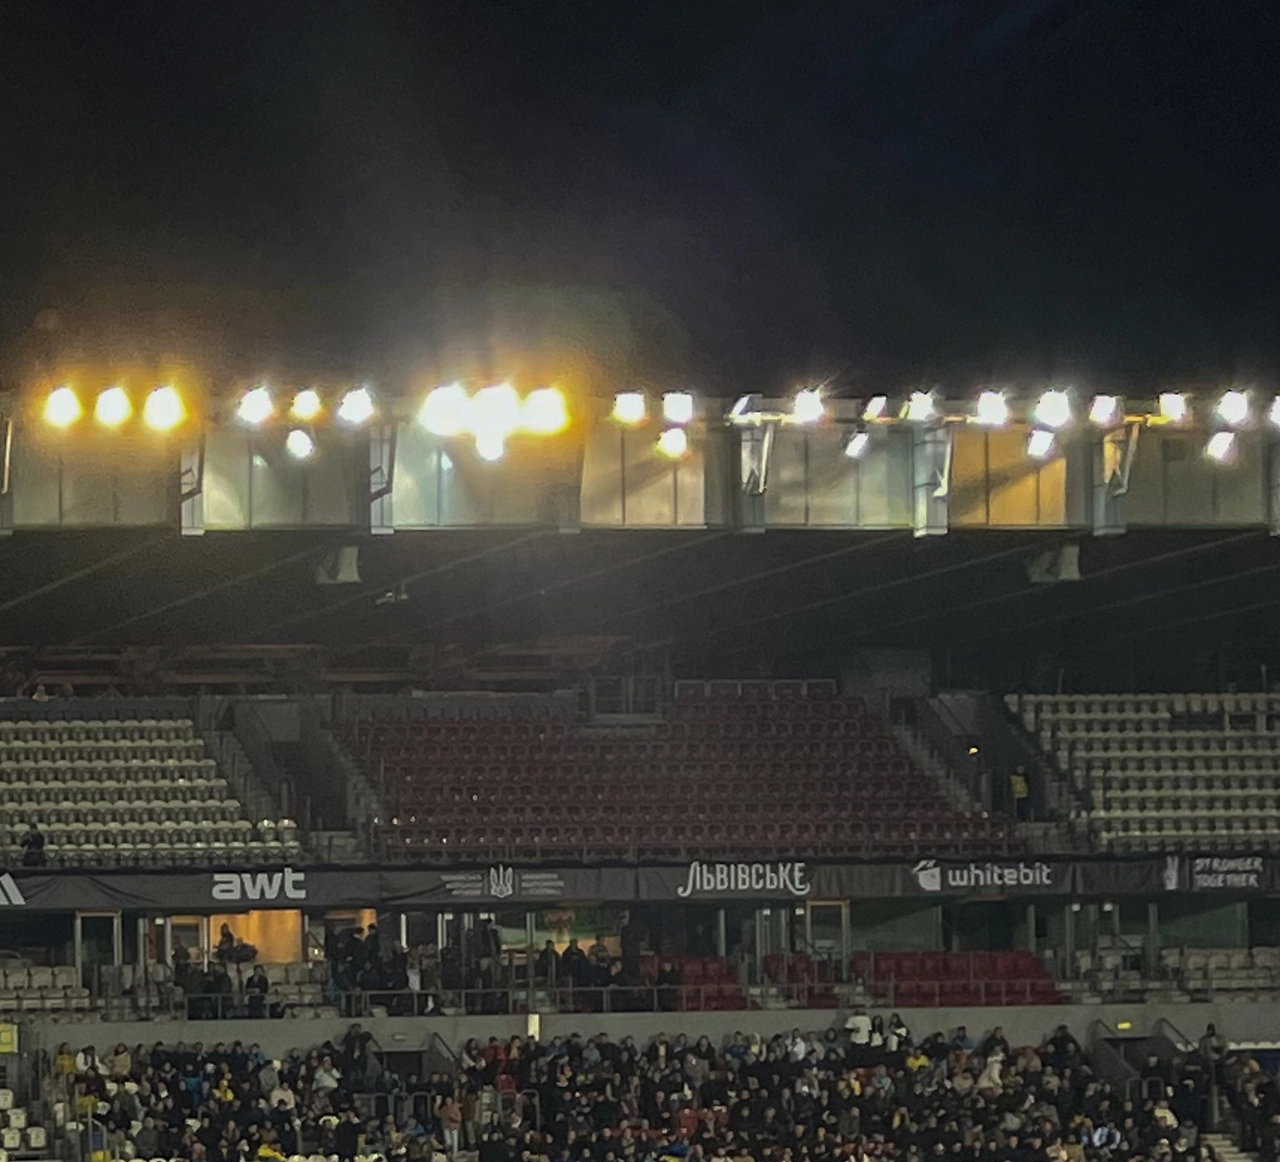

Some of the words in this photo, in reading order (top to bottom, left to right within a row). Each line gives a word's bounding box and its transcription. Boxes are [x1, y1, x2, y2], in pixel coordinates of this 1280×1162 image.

[948, 862, 1052, 887] whitebit
[1195, 857, 1264, 872] STRONGER
[211, 867, 307, 900] awt
[677, 861, 811, 897] ЛЬВІВСЬКЕ
[1194, 873, 1259, 888] TOGETHER
